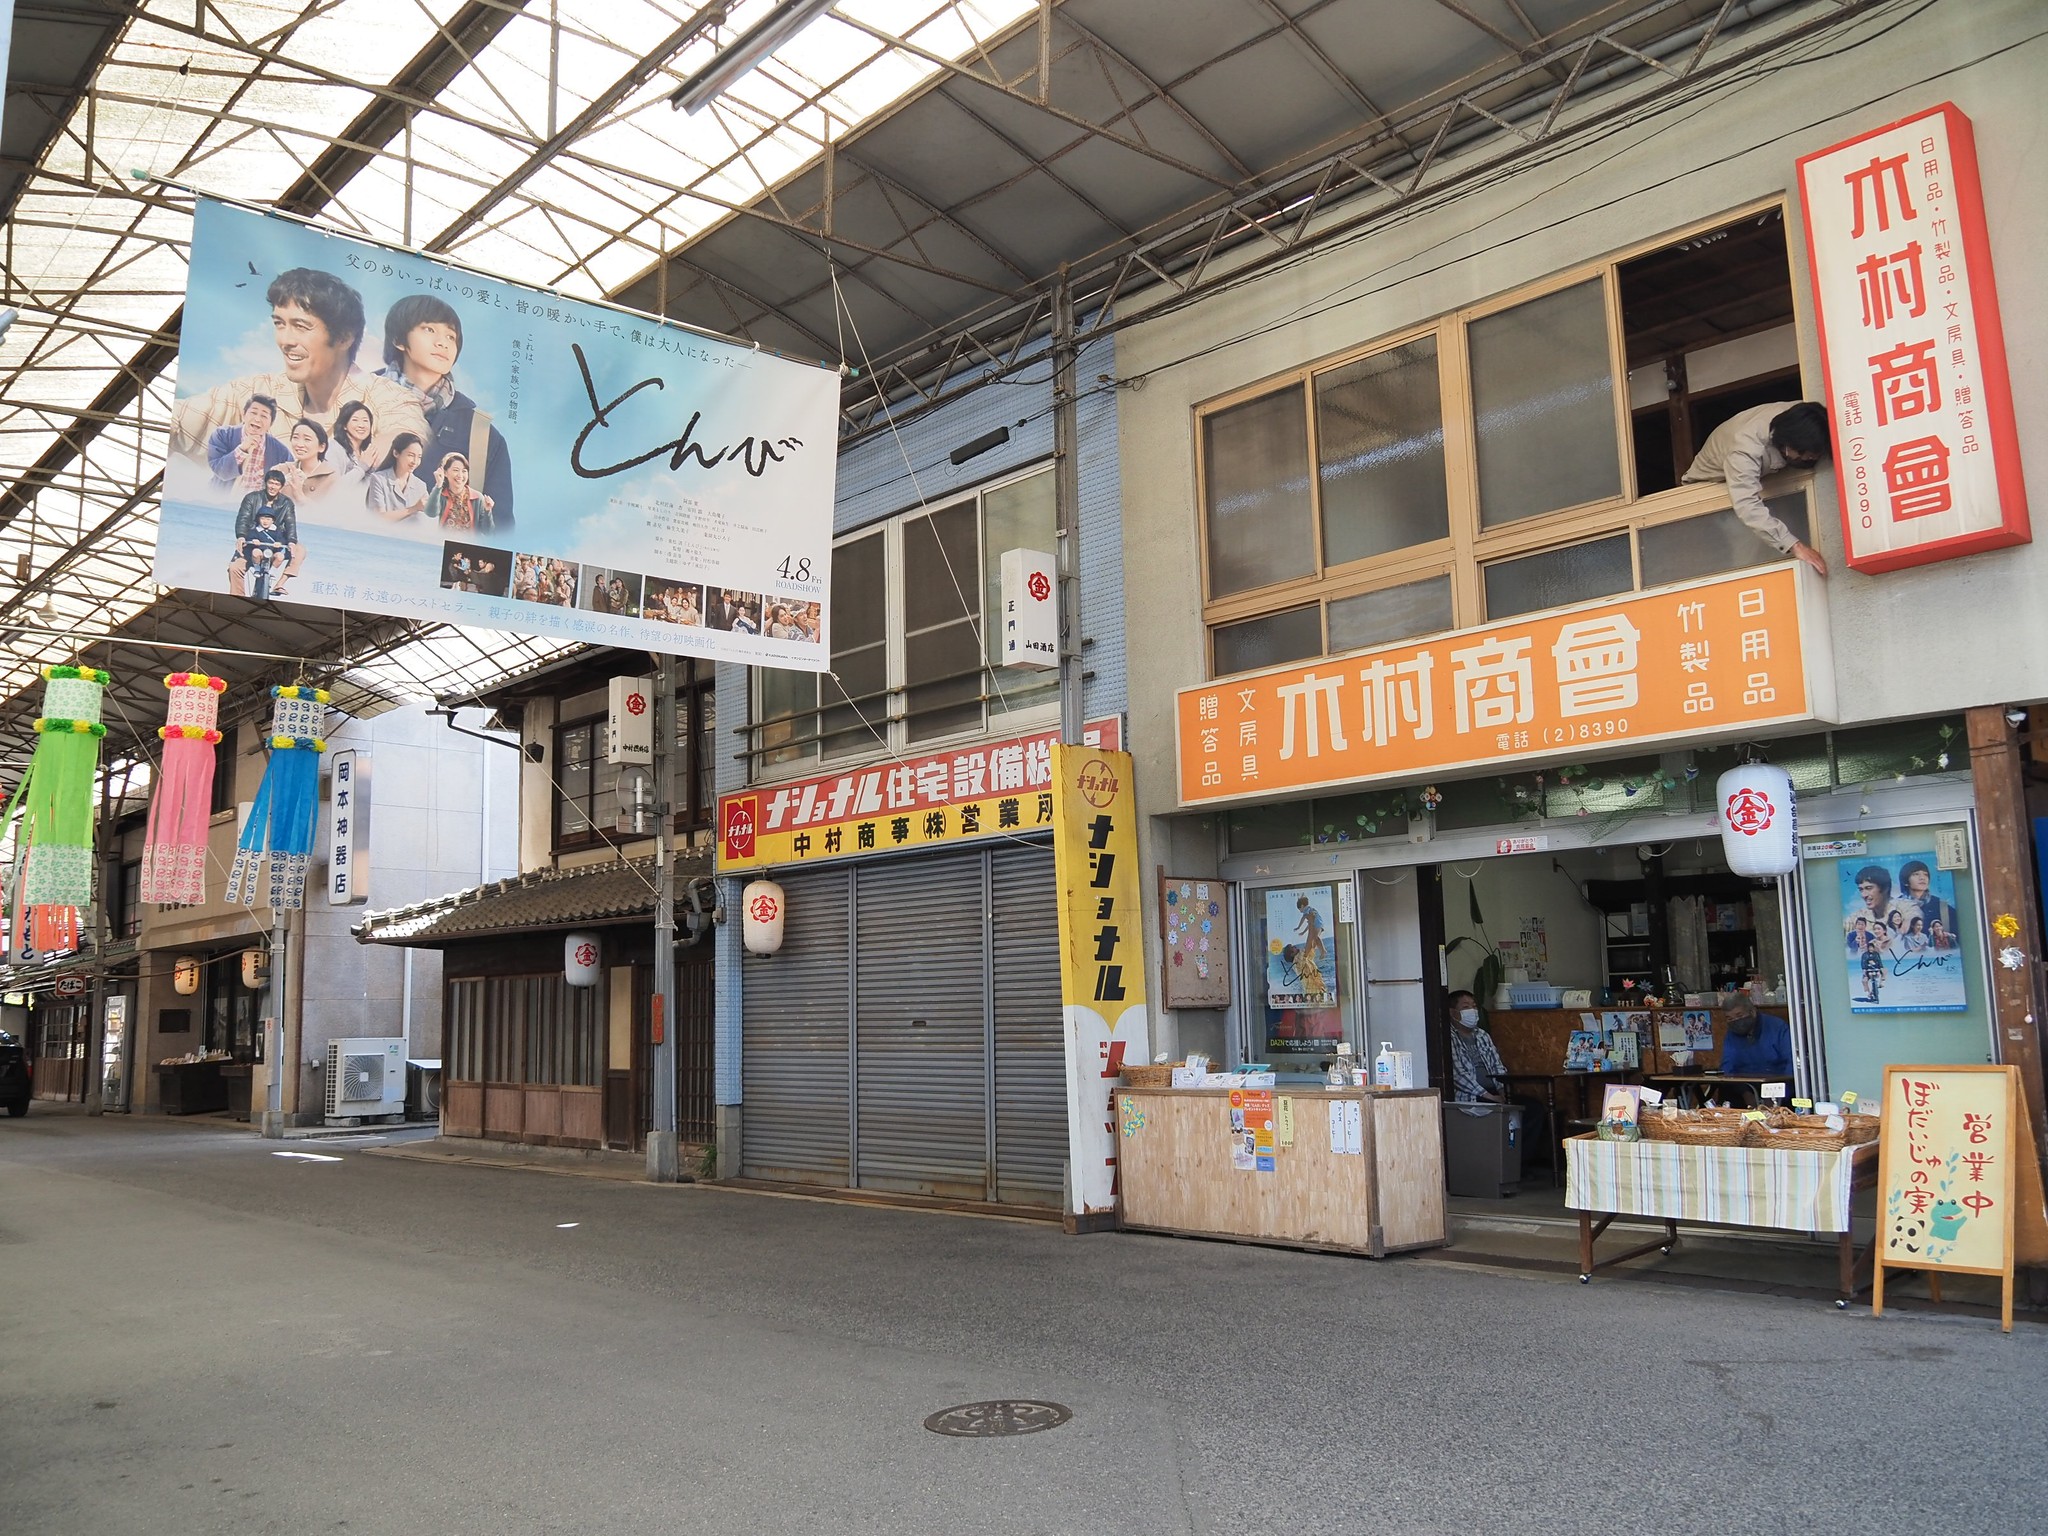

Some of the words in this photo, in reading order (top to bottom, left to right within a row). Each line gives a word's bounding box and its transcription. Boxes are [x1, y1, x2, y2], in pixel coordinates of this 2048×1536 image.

[1843, 152, 1953, 523] 木村商會
[571, 343, 804, 479] とんび
[775, 580, 821, 593] ROADSHOW
[776, 555, 811, 582] 4.8
[1276, 613, 1641, 761] 木村商會
[1677, 601, 1714, 714] 竹製品
[1737, 588, 1775, 706] 日用品
[766, 729, 1101, 829] ナショナル住宅設備機
[1077, 774, 1119, 793] ナショナル
[1199, 692, 1221, 787] 贈答品
[1237, 687, 1259, 782] 文房具
[1496, 730, 1529, 751] 電話
[334, 762, 350, 895] 岡本神器店
[1087, 814, 1127, 1002] ナショナル
[58, 980, 83, 991] たばこ
[1901, 1078, 1942, 1215] ぼだいじゅの実
[1961, 1113, 1995, 1218] 営業中
